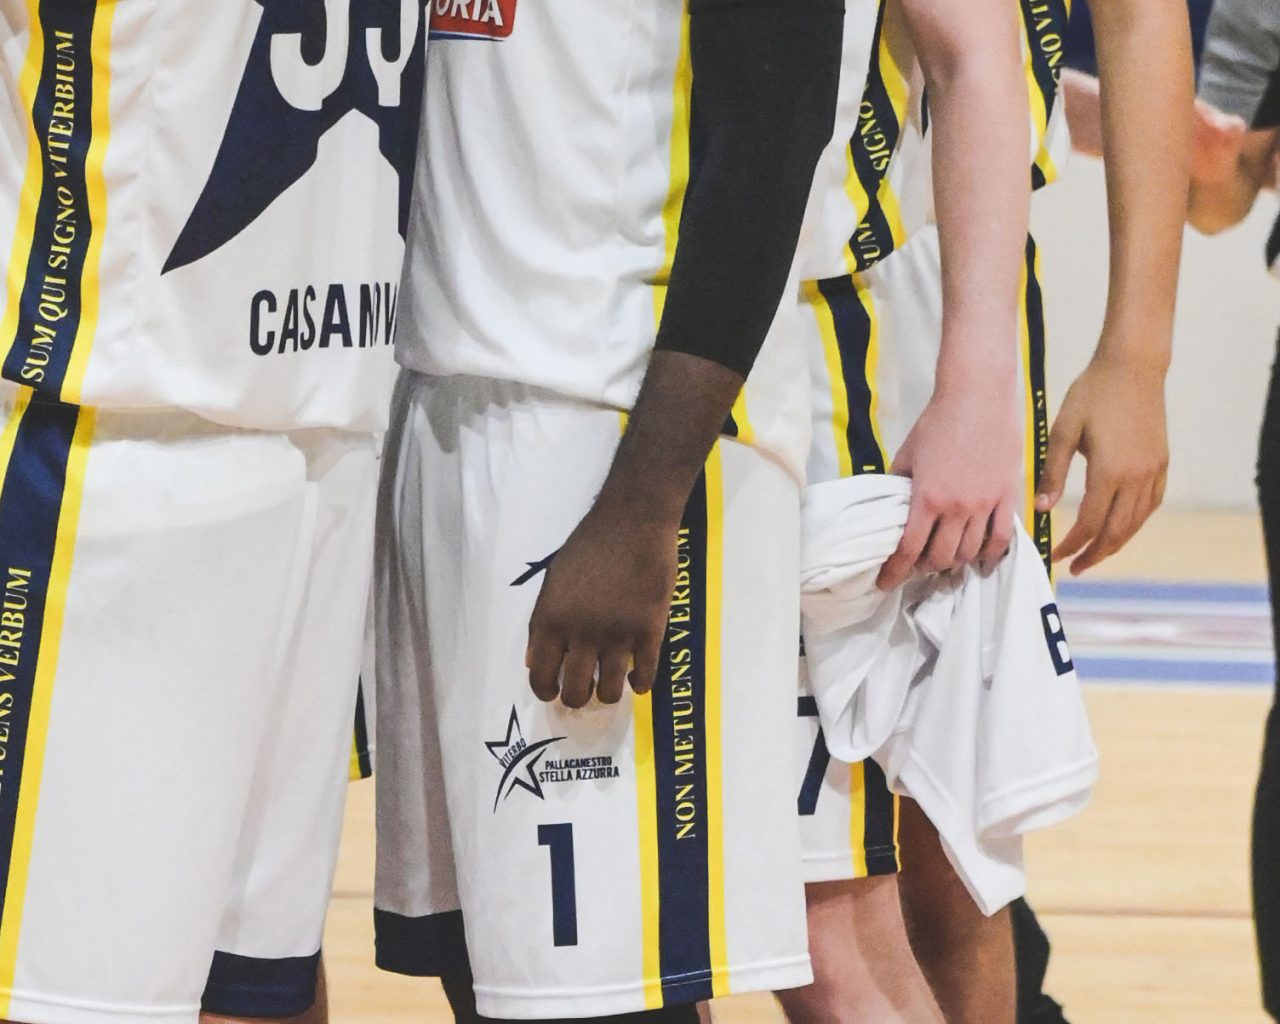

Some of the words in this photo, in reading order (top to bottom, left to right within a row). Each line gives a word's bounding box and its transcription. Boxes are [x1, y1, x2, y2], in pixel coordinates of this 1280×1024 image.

[47, 30, 76, 179] VITERBIUM
[48, 189, 76, 271] SIGNO
[38, 274, 68, 322] QUI
[20, 323, 57, 382] SUM
[670, 647, 695, 776] METUENS
[499, 737, 527, 769] VITERBO
[539, 769, 573, 783] STELLA
[575, 766, 620, 781] AZZURRA
[545, 756, 612, 770] PALLACANESTRO
[675, 783, 697, 841] NON
[537, 822, 578, 947] 1
